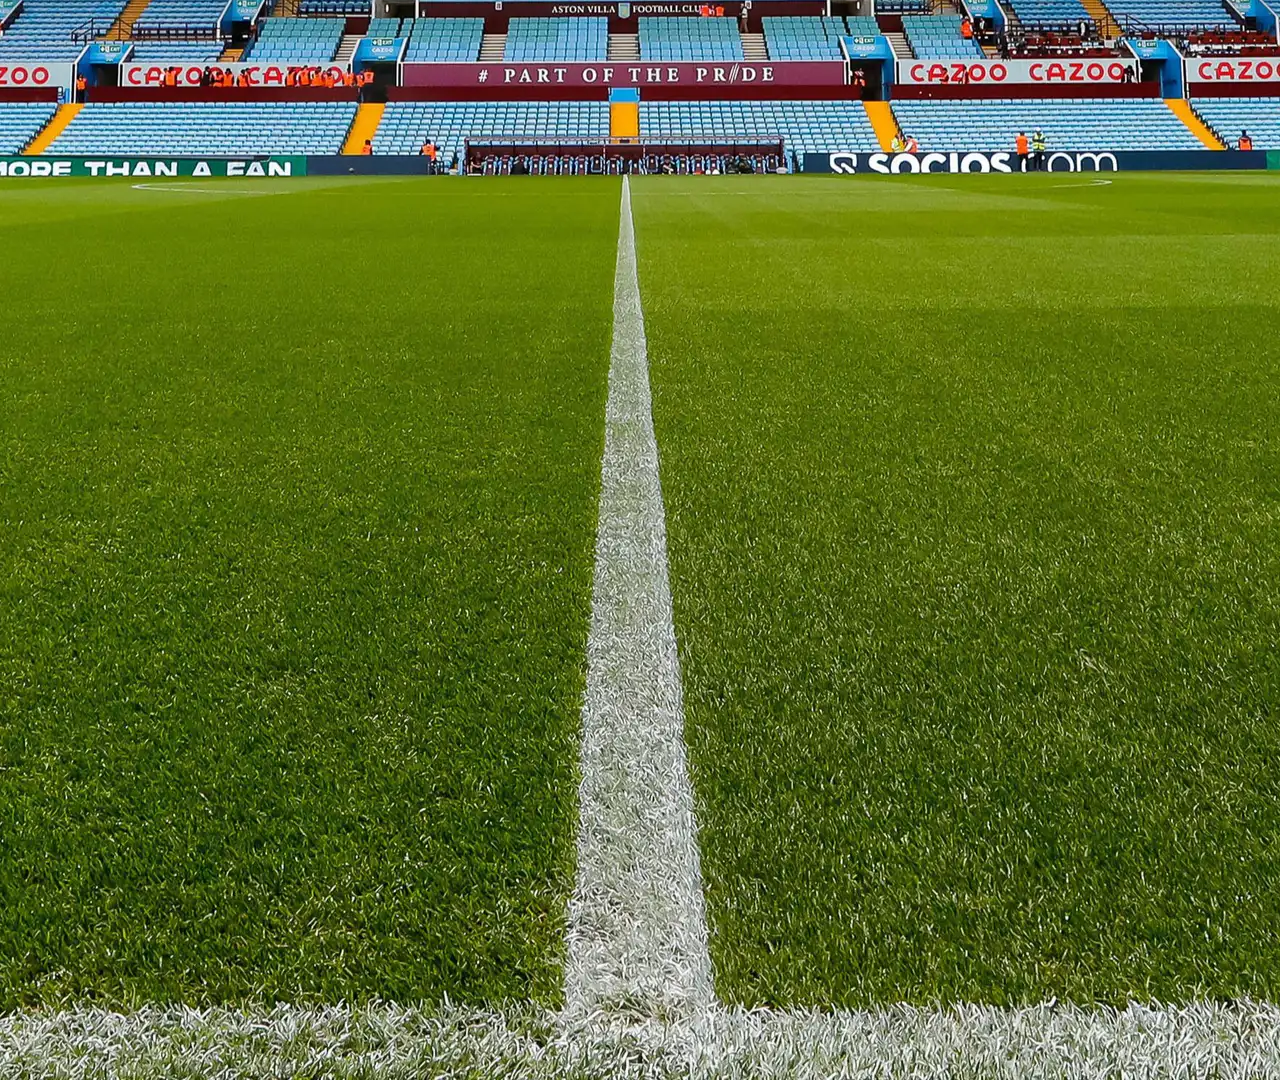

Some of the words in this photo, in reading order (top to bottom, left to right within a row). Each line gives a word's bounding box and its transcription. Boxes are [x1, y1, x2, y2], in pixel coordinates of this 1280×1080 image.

[552, 5, 585, 13] ASTON
[587, 5, 616, 13] VILLA
[632, 5, 681, 13] FOOTBALL
[682, 5, 703, 13] CLU
[478, 69, 489, 82] #
[504, 69, 567, 83] PART
[582, 68, 614, 83] OF
[628, 67, 679, 82] THE
[910, 64, 1007, 82] CAZOO
[1029, 63, 1125, 81] CAZOO
[84, 161, 178, 176] THAN
[191, 161, 212, 176] A
[226, 162, 291, 176] FAN
